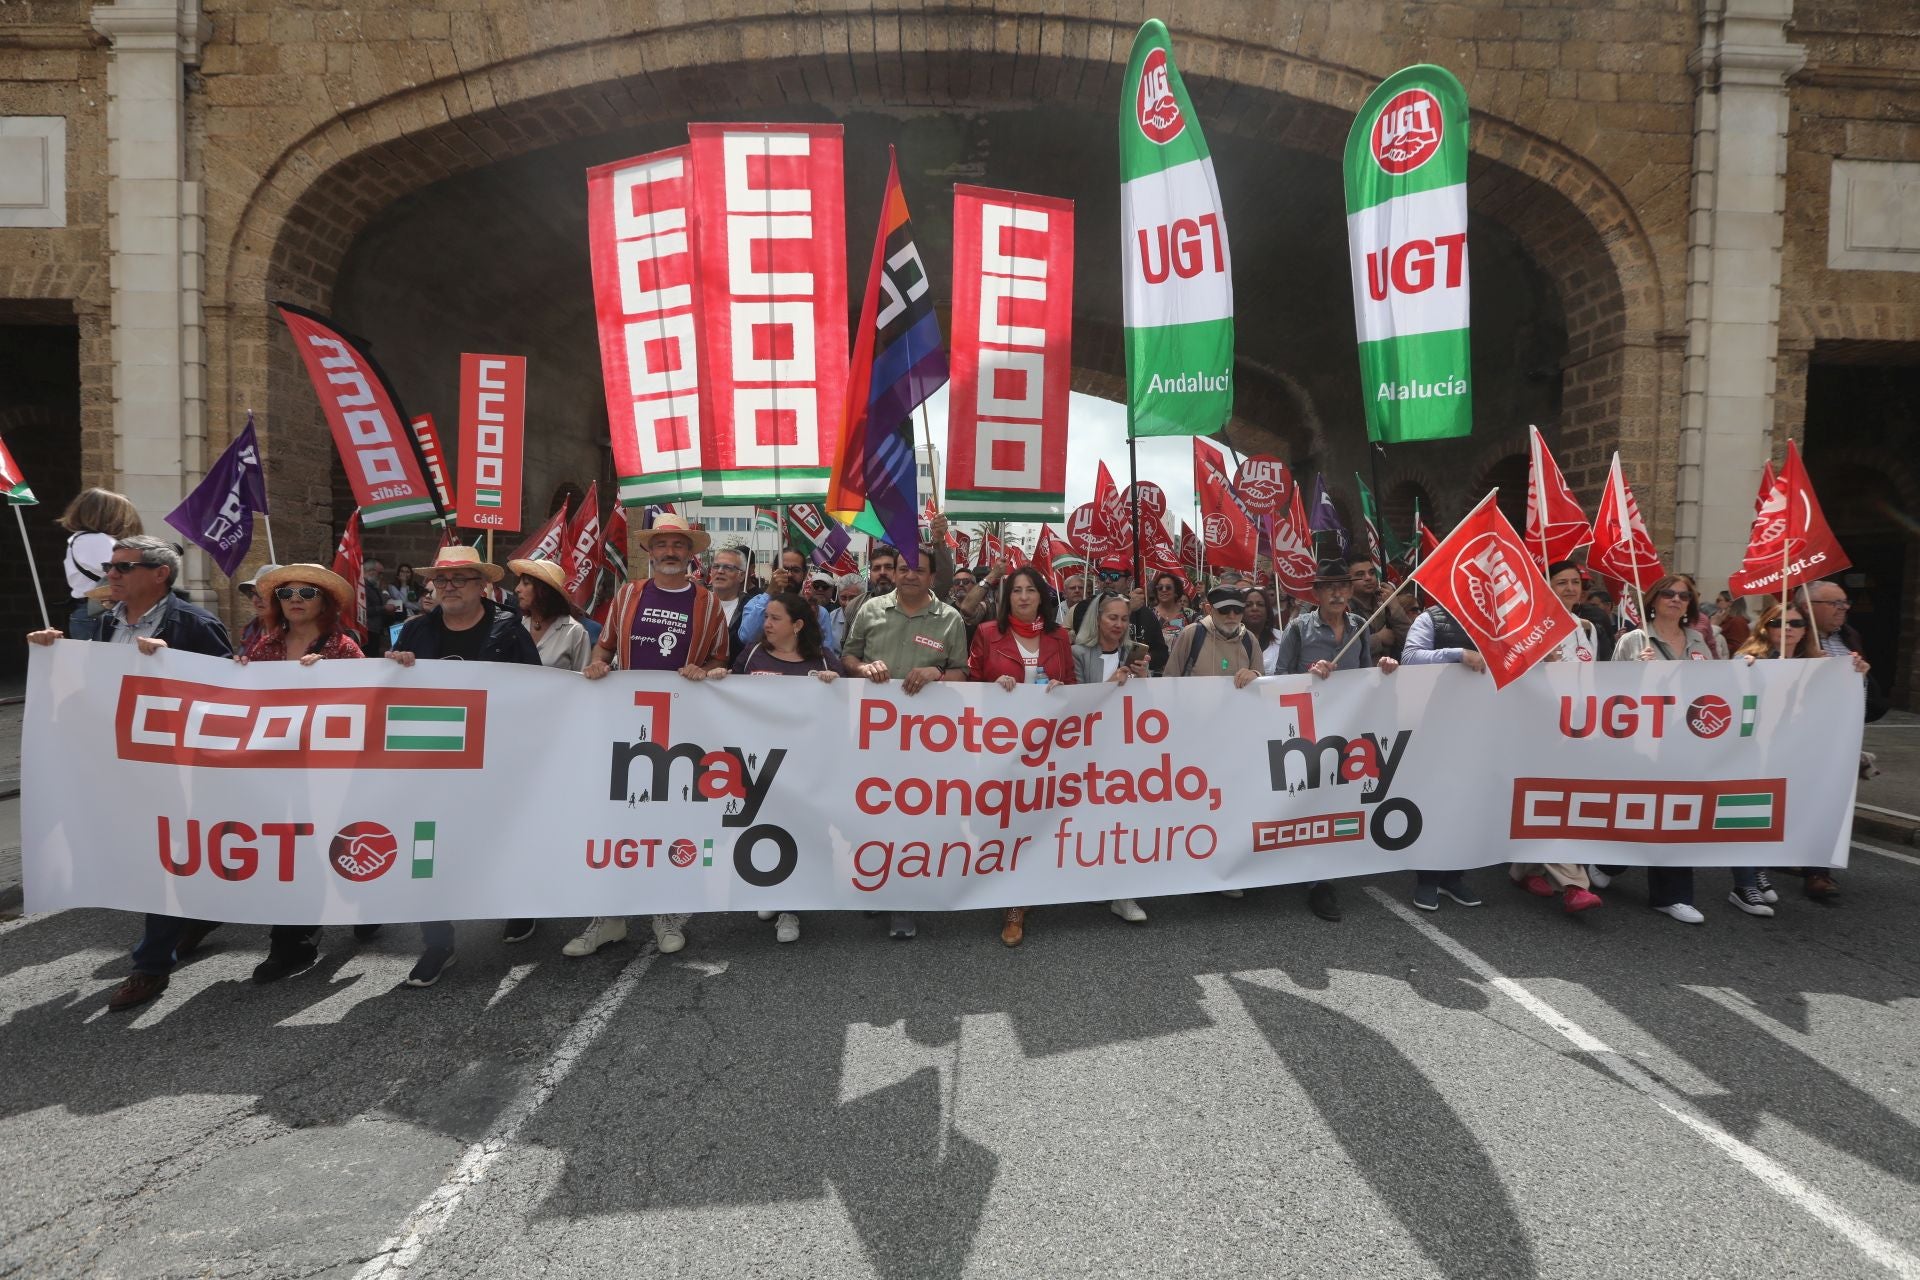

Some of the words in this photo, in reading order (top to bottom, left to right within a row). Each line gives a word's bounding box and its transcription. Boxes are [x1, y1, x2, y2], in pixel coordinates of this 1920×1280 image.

[1143, 63, 1168, 111] UG
[1381, 100, 1431, 142] UGT
[1137, 212, 1224, 284] UGT
[1366, 232, 1466, 301] UGT
[614, 157, 700, 473] CCOO
[723, 132, 819, 466] CCOO
[974, 203, 1049, 489] CCOO
[1147, 368, 1229, 394] Andalucí
[476, 360, 506, 485] CCOO
[1242, 460, 1283, 483] UGT
[473, 513, 503, 526] Cádiz
[1743, 551, 1827, 589] www.ugt.es
[641, 616, 687, 628] enseñanza
[643, 608, 679, 620] CCOO
[1502, 615, 1555, 670] www.ugt.es
[130, 694, 366, 751] CCOO
[858, 698, 1102, 767] Proteger
[1123, 696, 1170, 744] lo
[1559, 695, 1675, 739] UGT
[855, 753, 1223, 828] conquistado,
[1523, 790, 1703, 831] CCOO
[157, 816, 314, 882] UGT
[586, 839, 662, 869] UGT
[852, 830, 1031, 892] ganar
[1055, 817, 1218, 868] futuro
[1259, 820, 1329, 846] CCOO
